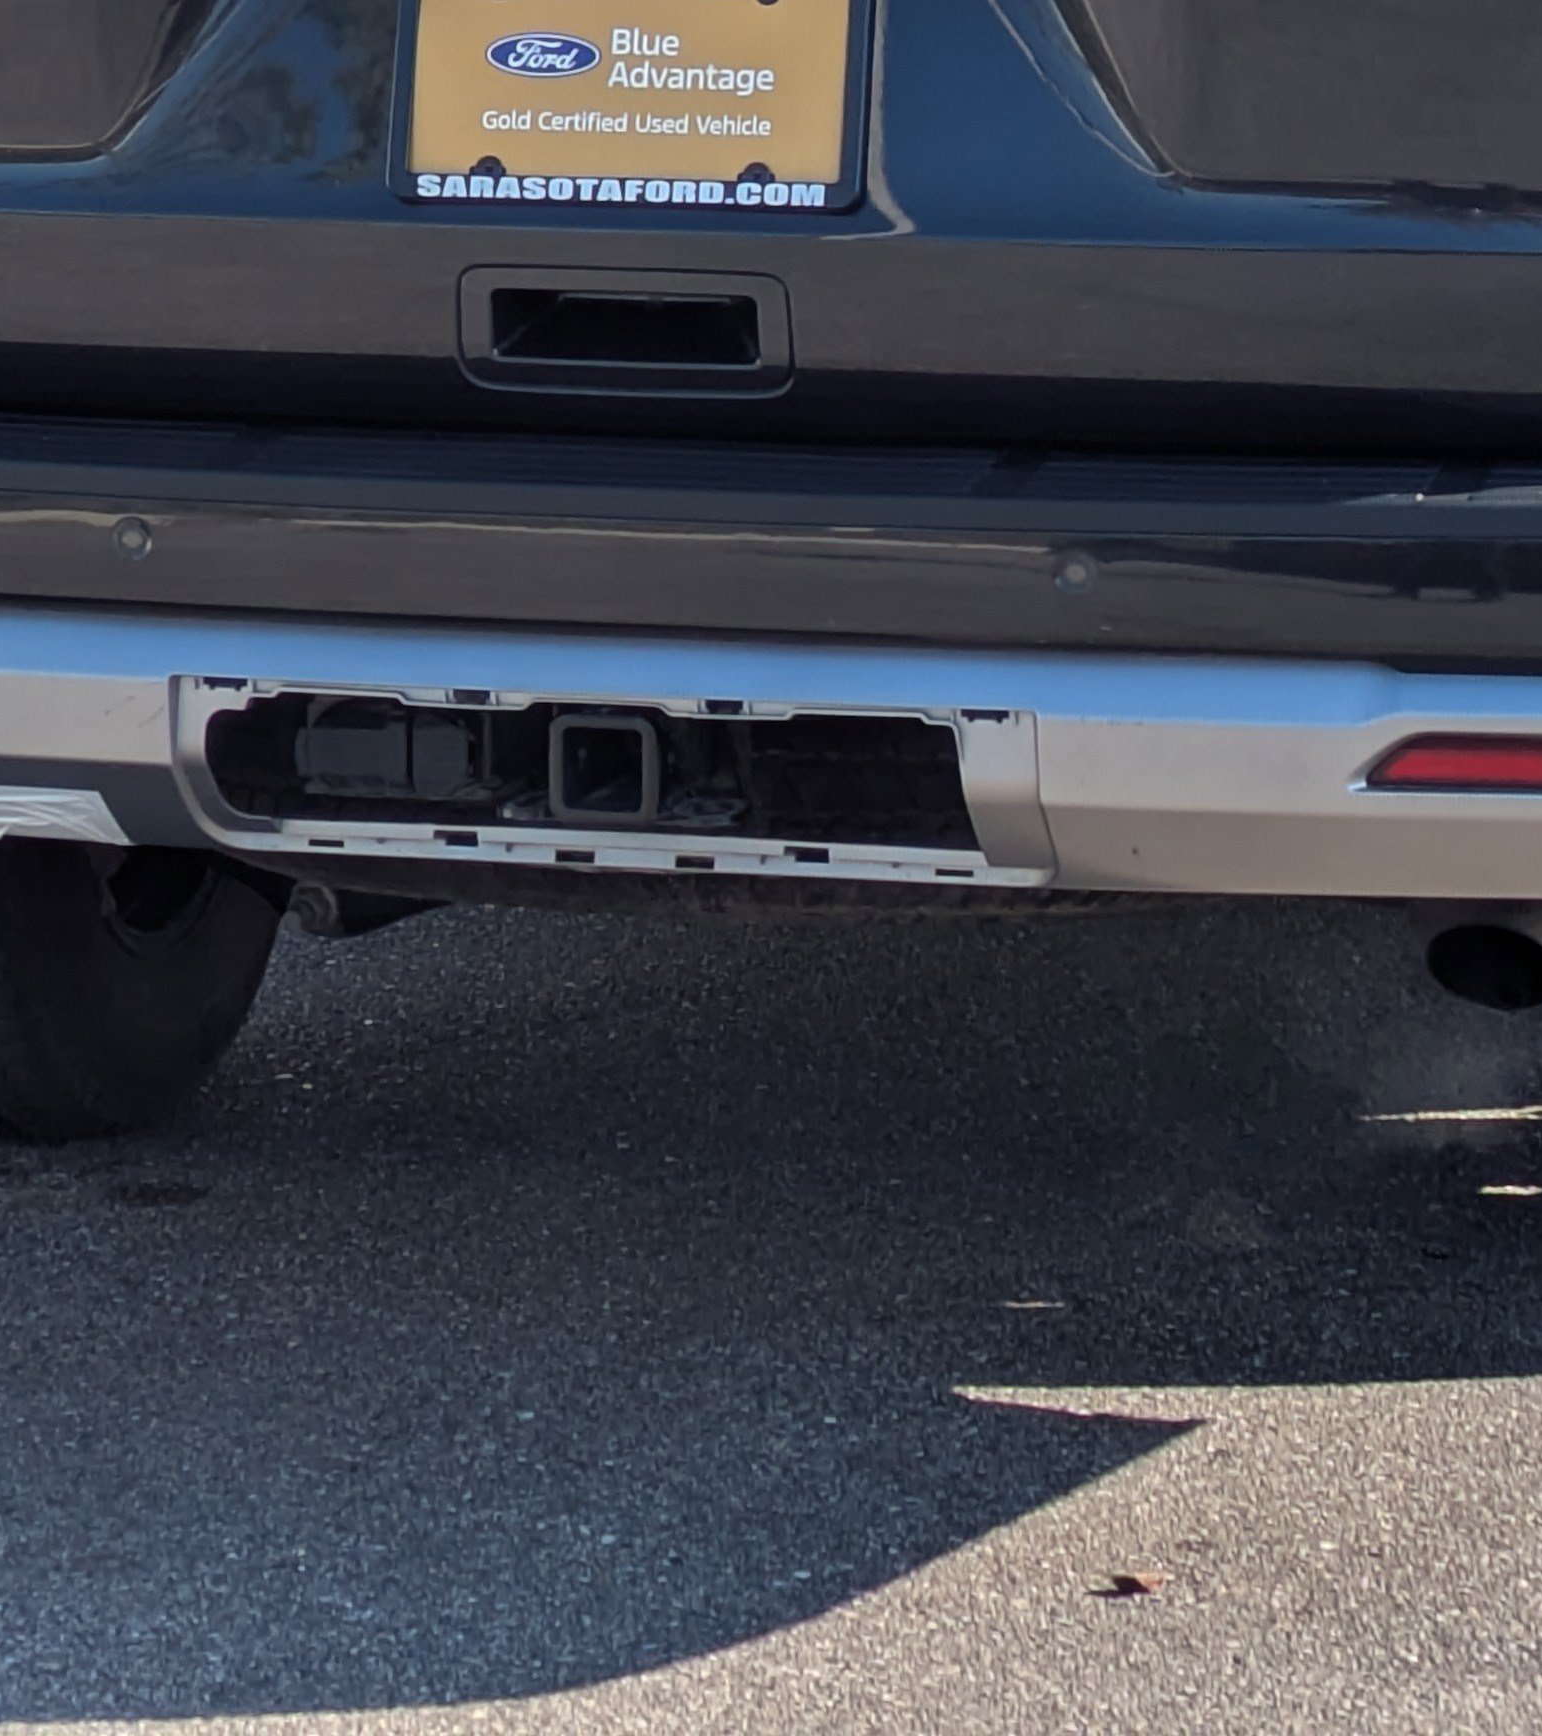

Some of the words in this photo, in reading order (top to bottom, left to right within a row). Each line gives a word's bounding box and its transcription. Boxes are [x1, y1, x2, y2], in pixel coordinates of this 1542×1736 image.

[507, 39, 578, 71] Ford
[611, 28, 680, 57] Blue
[607, 62, 775, 96] Advantage
[481, 110, 531, 131] Gold
[537, 111, 628, 134] Certified
[634, 114, 690, 135] Used
[695, 115, 772, 137] Vehicle
[416, 173, 827, 208] SARASOTAFORD.COM
